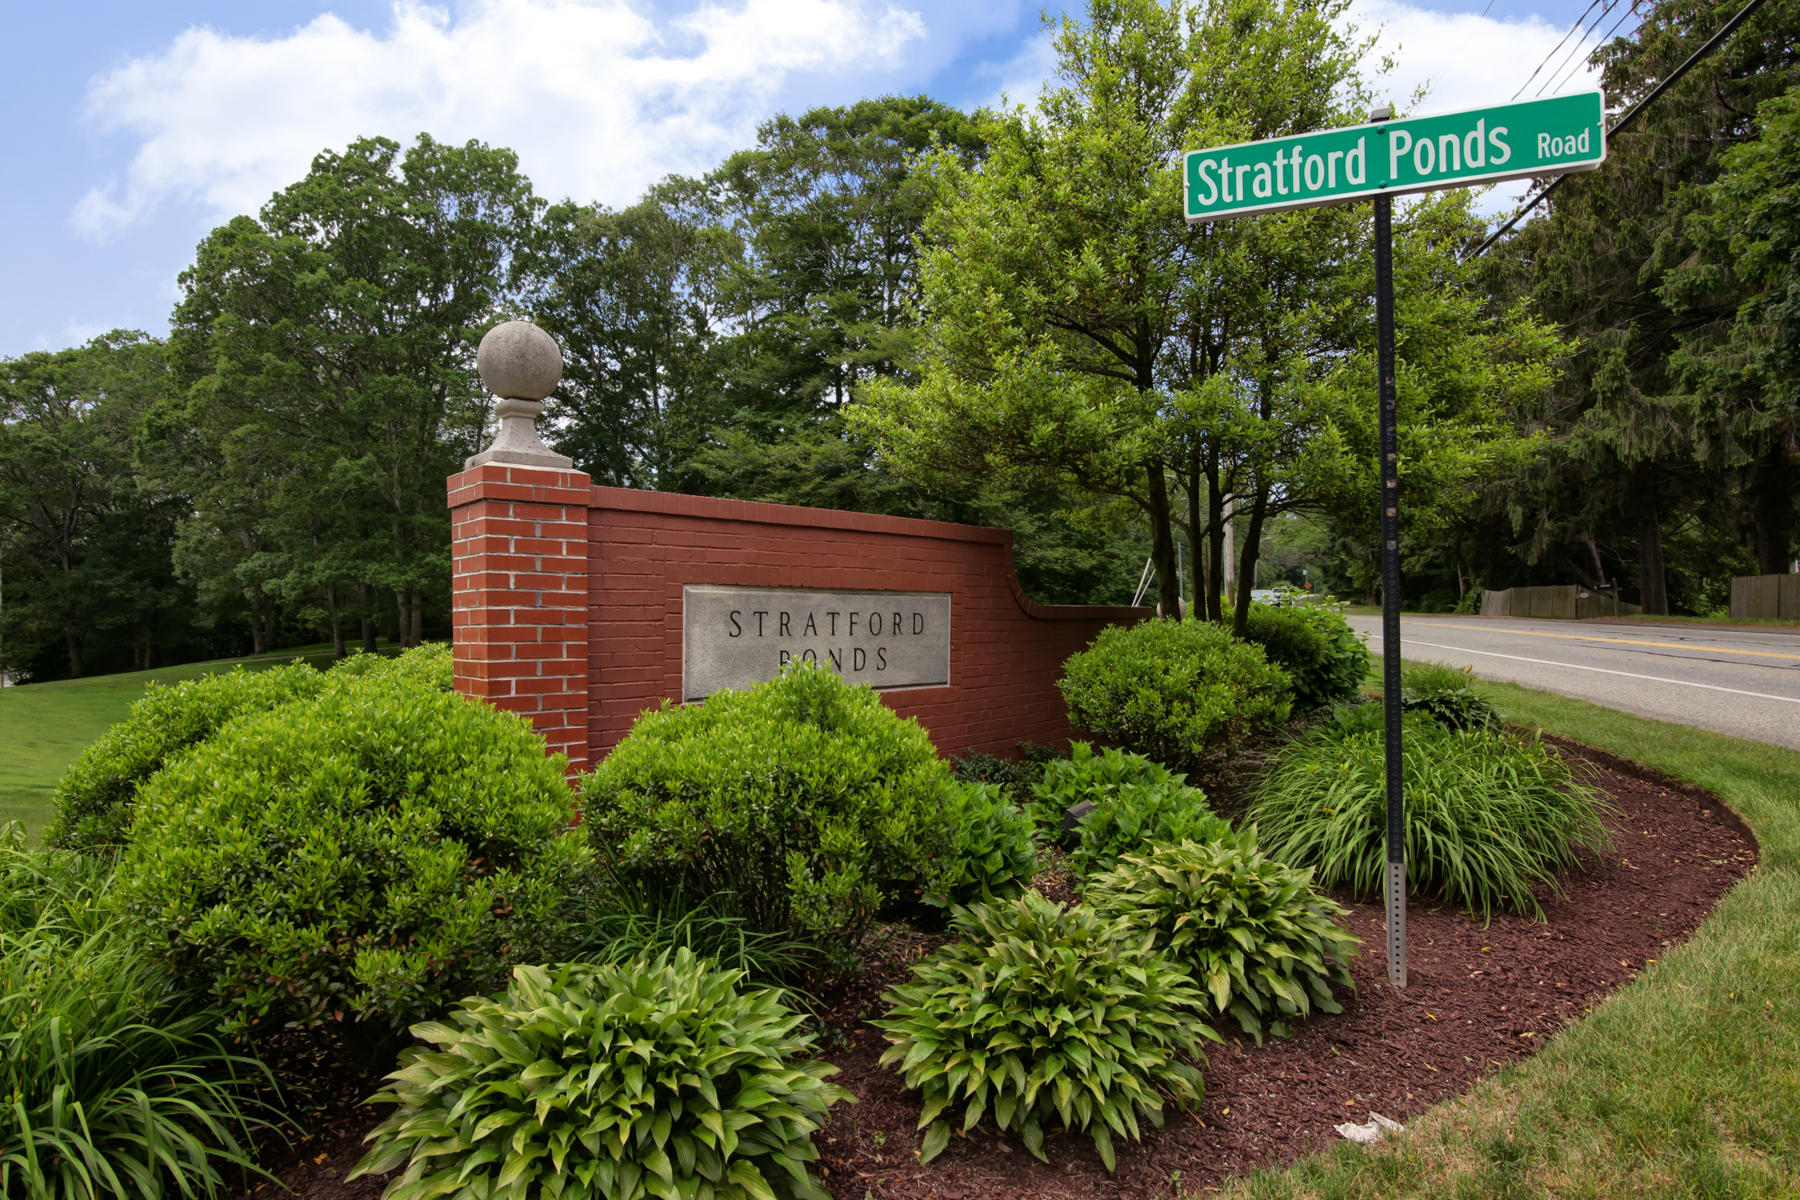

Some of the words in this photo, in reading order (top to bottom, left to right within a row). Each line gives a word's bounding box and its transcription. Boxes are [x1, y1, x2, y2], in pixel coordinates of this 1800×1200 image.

[1198, 136, 1366, 206] Stratford
[1389, 117, 1511, 180] Ponds
[1537, 127, 1590, 159] Road
[728, 610, 924, 637] STRATFORD
